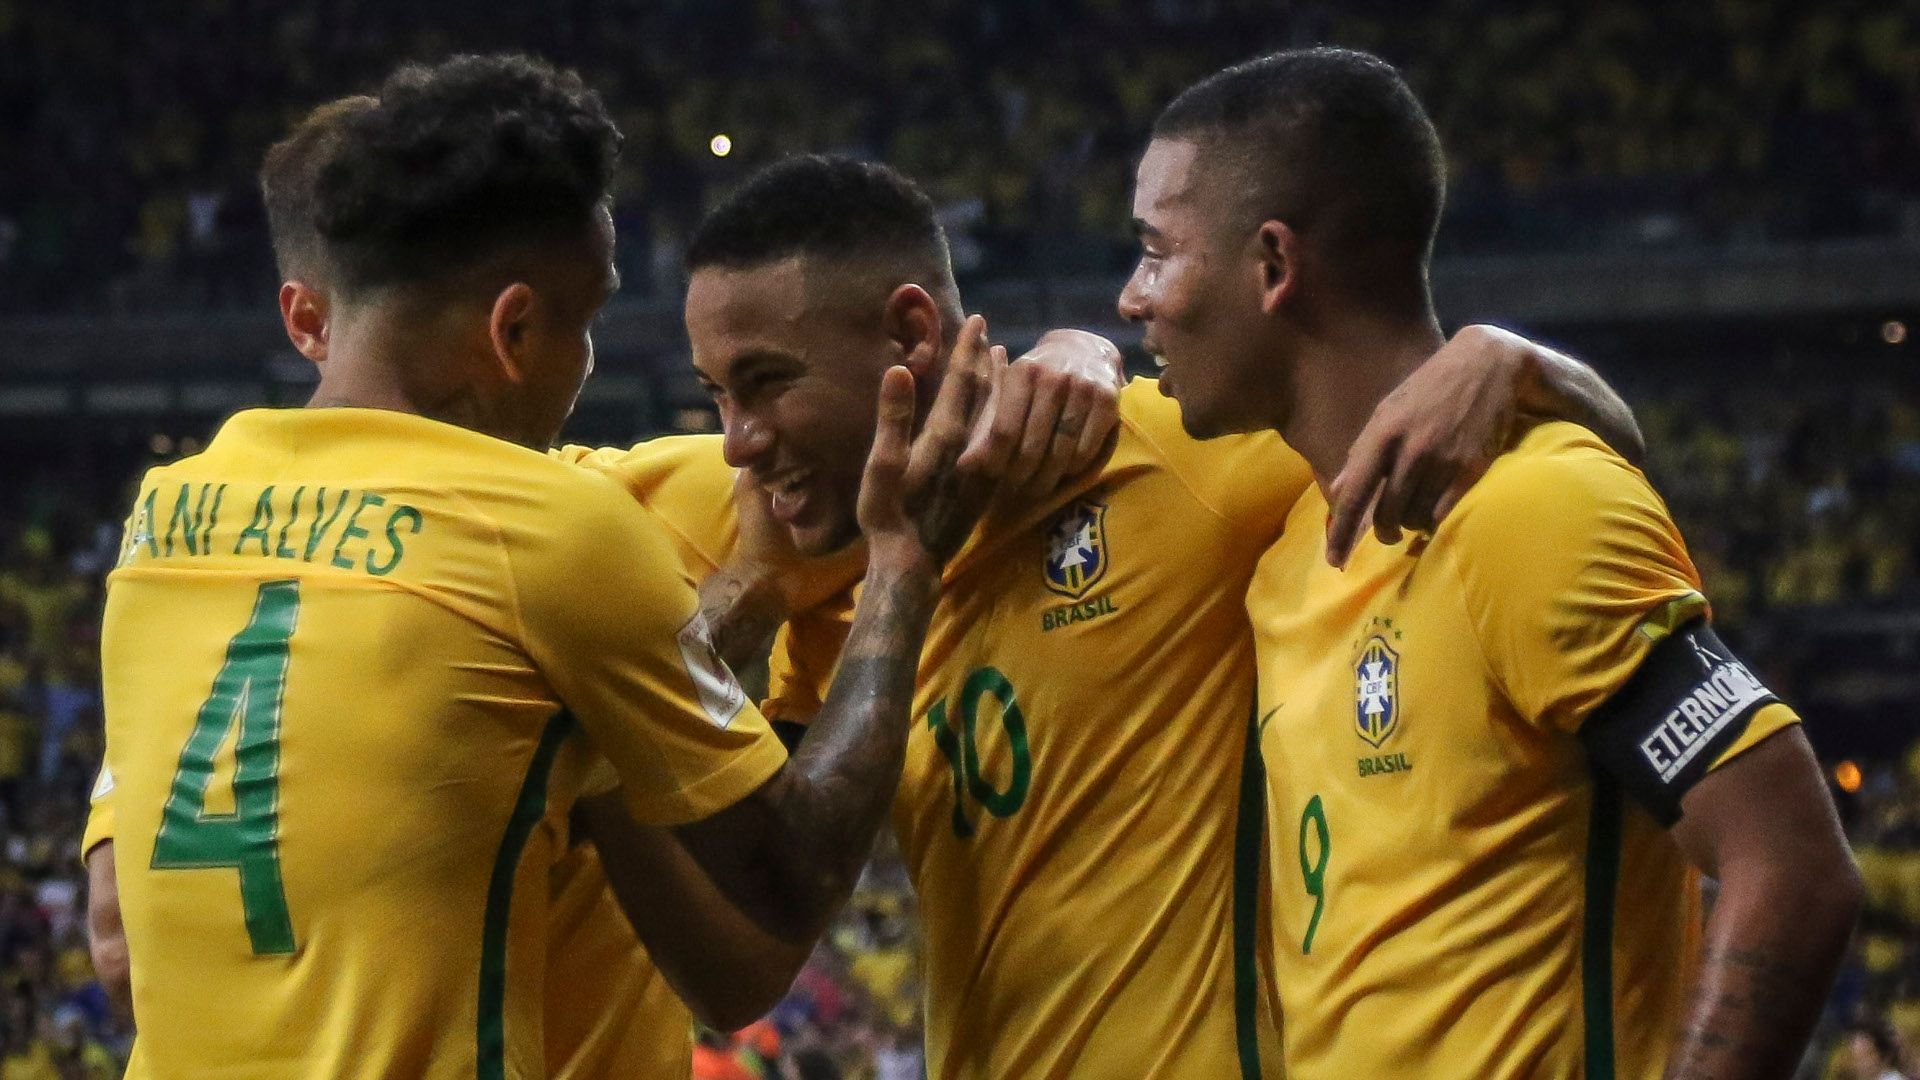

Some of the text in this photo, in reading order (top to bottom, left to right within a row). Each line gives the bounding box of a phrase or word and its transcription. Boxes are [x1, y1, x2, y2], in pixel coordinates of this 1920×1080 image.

[233, 485, 423, 576] ALVES
[1042, 597, 1119, 631] BRASIL
[150, 579, 300, 954] 4
[928, 666, 1032, 838] 10
[1358, 752, 1413, 778] BRASIL
[1640, 664, 1741, 774] ETERNO
[1299, 795, 1330, 955] 9
